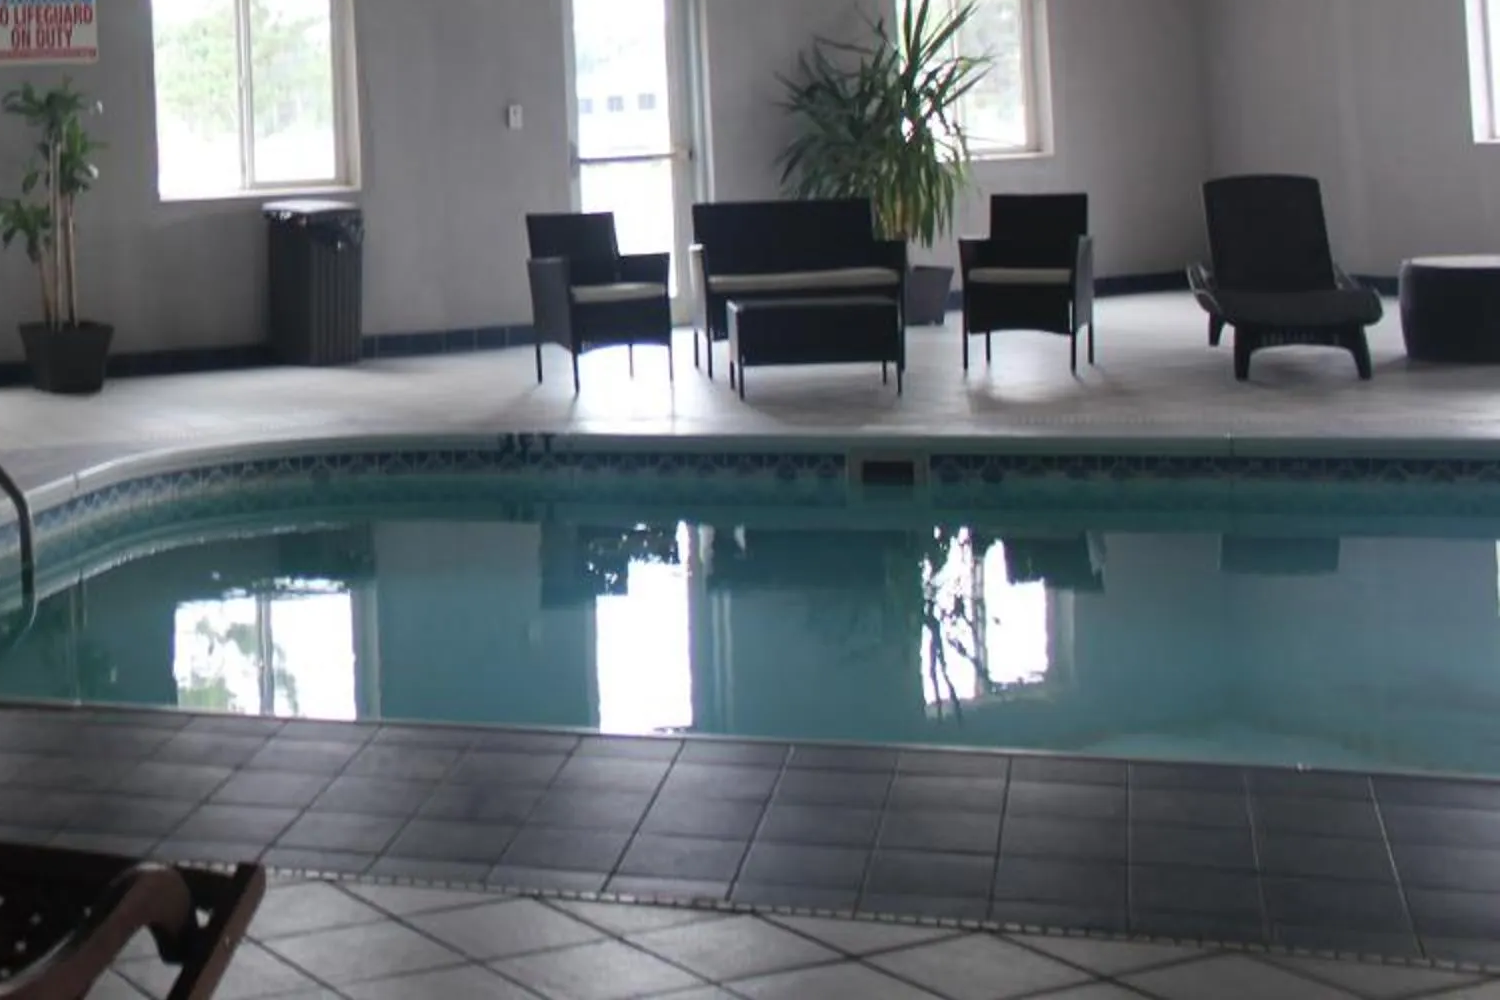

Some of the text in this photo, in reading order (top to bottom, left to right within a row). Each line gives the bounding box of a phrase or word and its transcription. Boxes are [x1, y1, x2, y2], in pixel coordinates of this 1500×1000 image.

[13, 3, 94, 25] LIFEGUARD
[11, 26, 73, 49] ON DUTY
